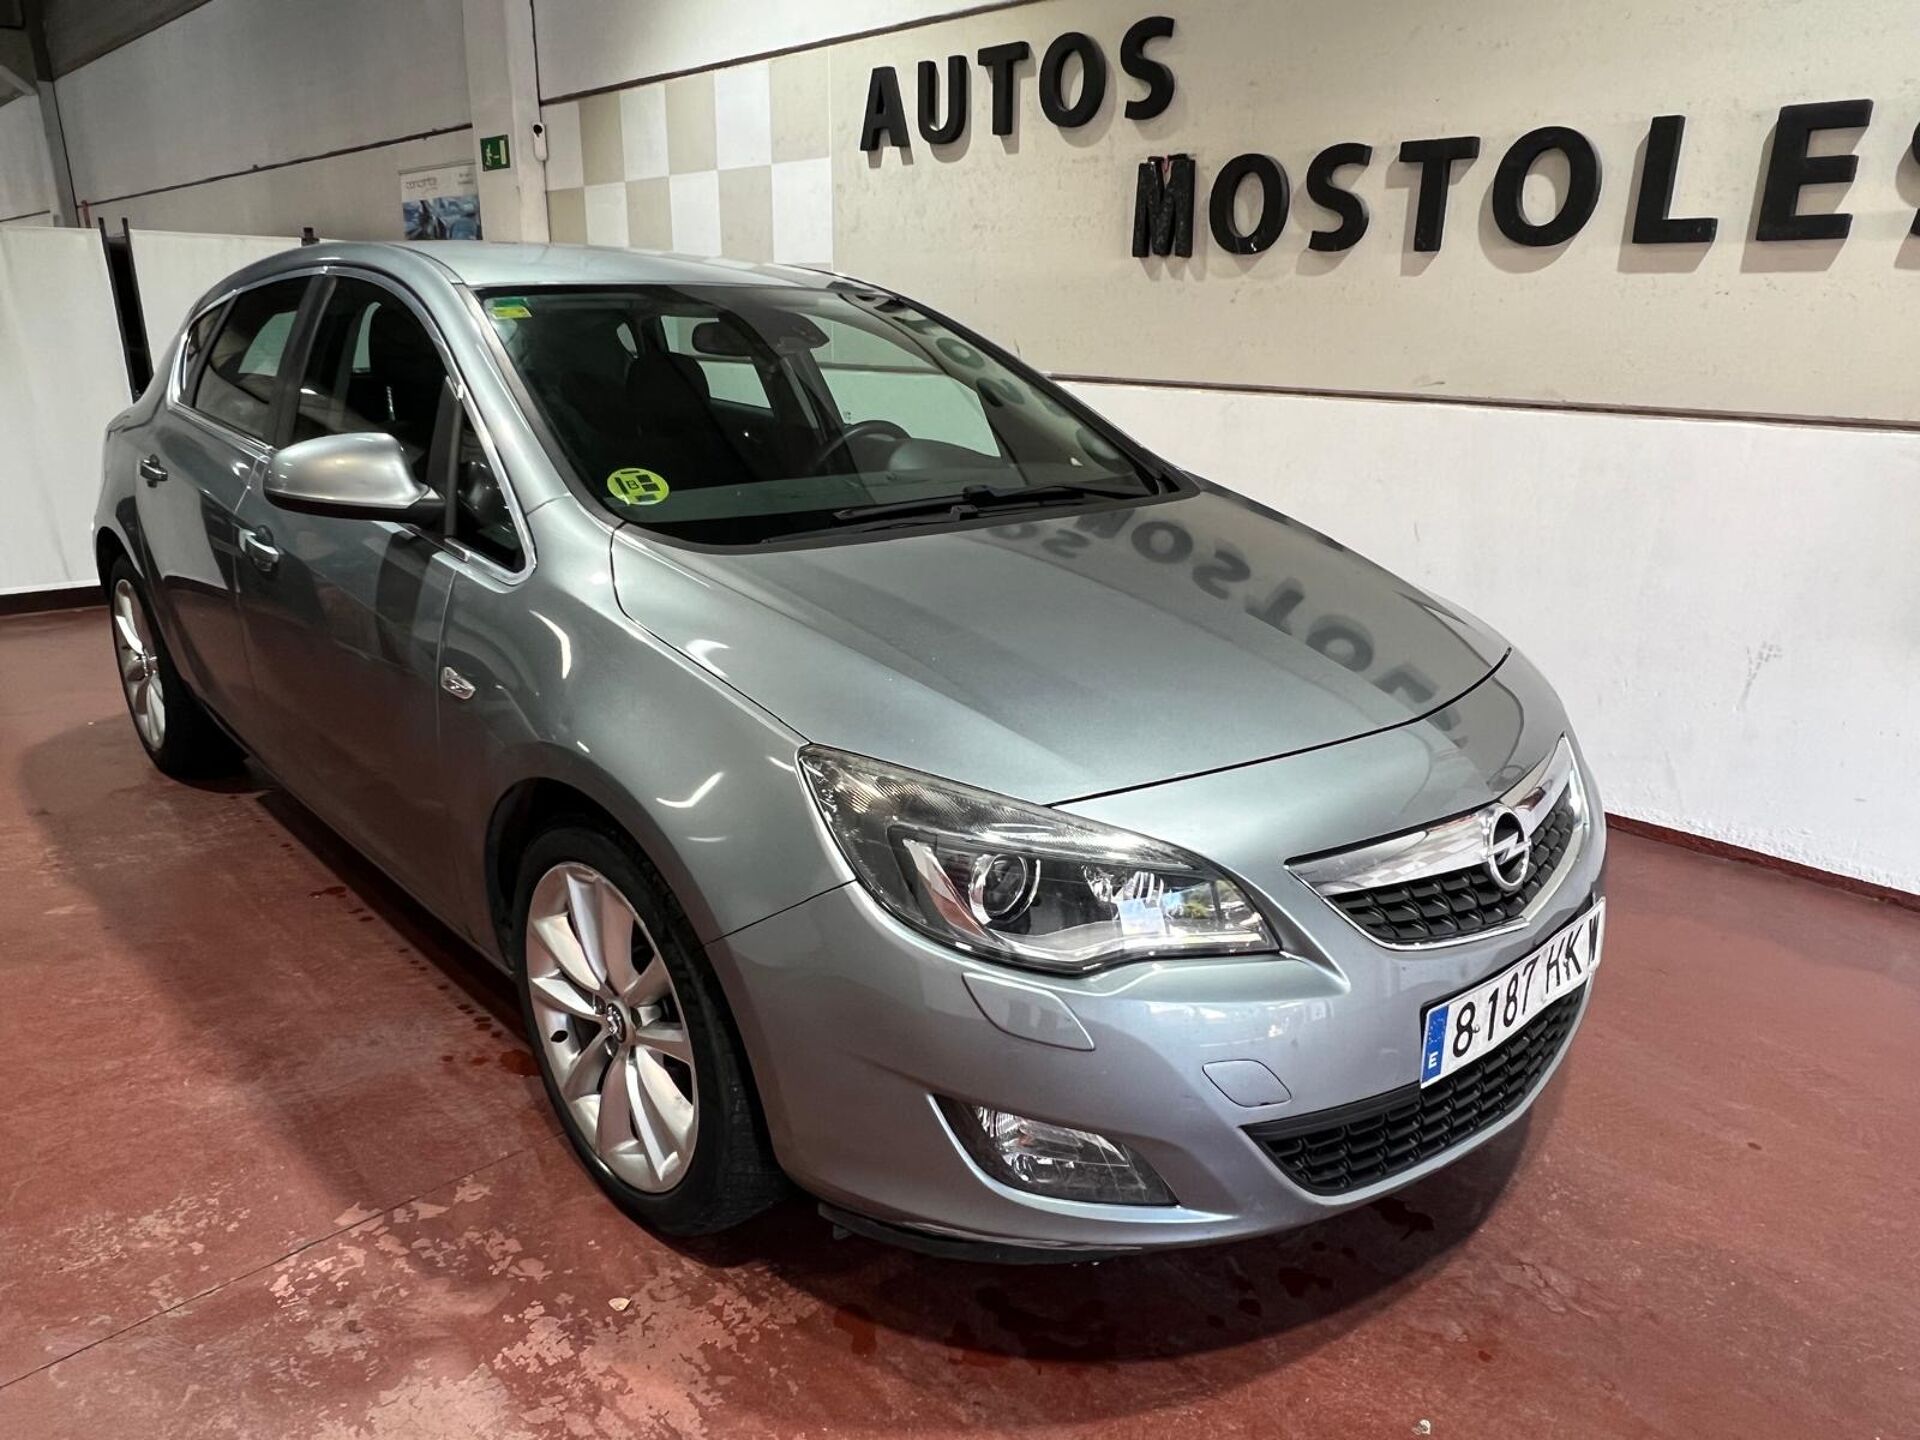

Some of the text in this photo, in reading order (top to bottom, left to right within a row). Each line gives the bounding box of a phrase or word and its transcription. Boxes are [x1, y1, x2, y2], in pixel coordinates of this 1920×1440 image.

[860, 16, 1176, 152] AUTOS
[1132, 98, 1920, 258] MOSTOLE
[1428, 1051, 1439, 1069] E
[1452, 955, 1541, 1058] 8187
